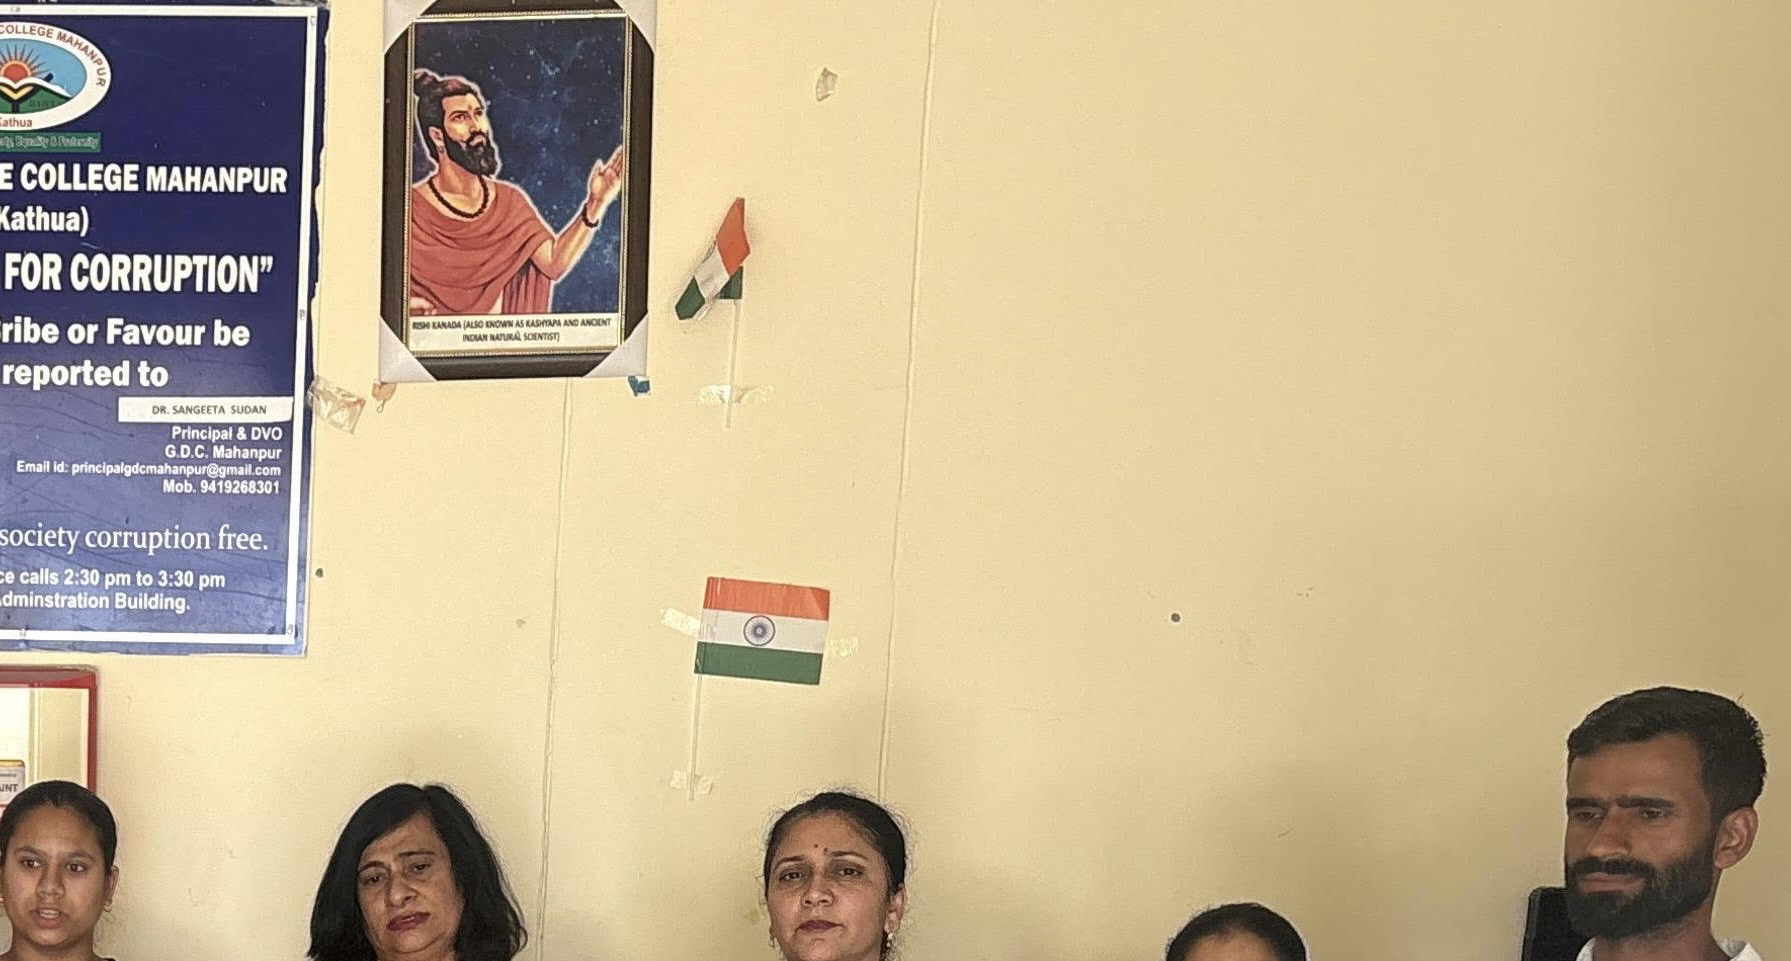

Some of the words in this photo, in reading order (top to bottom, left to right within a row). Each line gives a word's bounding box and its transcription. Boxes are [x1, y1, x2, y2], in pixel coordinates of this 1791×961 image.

[57, 32, 107, 87] MAHANPUR
[21, 163, 139, 191] COLLEGE
[147, 167, 287, 192] MAHANPUR
[5, 253, 61, 290] FOR
[71, 254, 273, 292] CORRUPTION”
[68, 324, 98, 344] or
[107, 318, 205, 345] Favour
[214, 319, 250, 346] be
[3, 358, 130, 392] reported
[138, 361, 168, 387] to
[152, 405, 169, 415] DR.
[172, 405, 225, 415] SANGEETA
[231, 405, 266, 414] SUDAN
[172, 426, 232, 443] Principal
[237, 427, 246, 440] &
[251, 427, 282, 440] DVO
[165, 445, 208, 458] G.D.C.
[213, 445, 282, 462] Mahanpur
[17, 460, 50, 472] Email
[54, 461, 68, 472] id:
[72, 462, 281, 478] principalgdcmahanpur@gmail.com
[163, 479, 196, 493] Mob.
[201, 480, 279, 494] 9419268301
[0, 523, 79, 554] society
[85, 525, 210, 555] corruption
[219, 524, 267, 550] free.
[20, 568, 58, 585] calls
[64, 569, 99, 585] 2:30
[105, 573, 130, 589] pm
[136, 571, 153, 586] to
[158, 570, 193, 587] 3:30
[199, 575, 225, 591] pm
[115, 592, 190, 614] Building.
